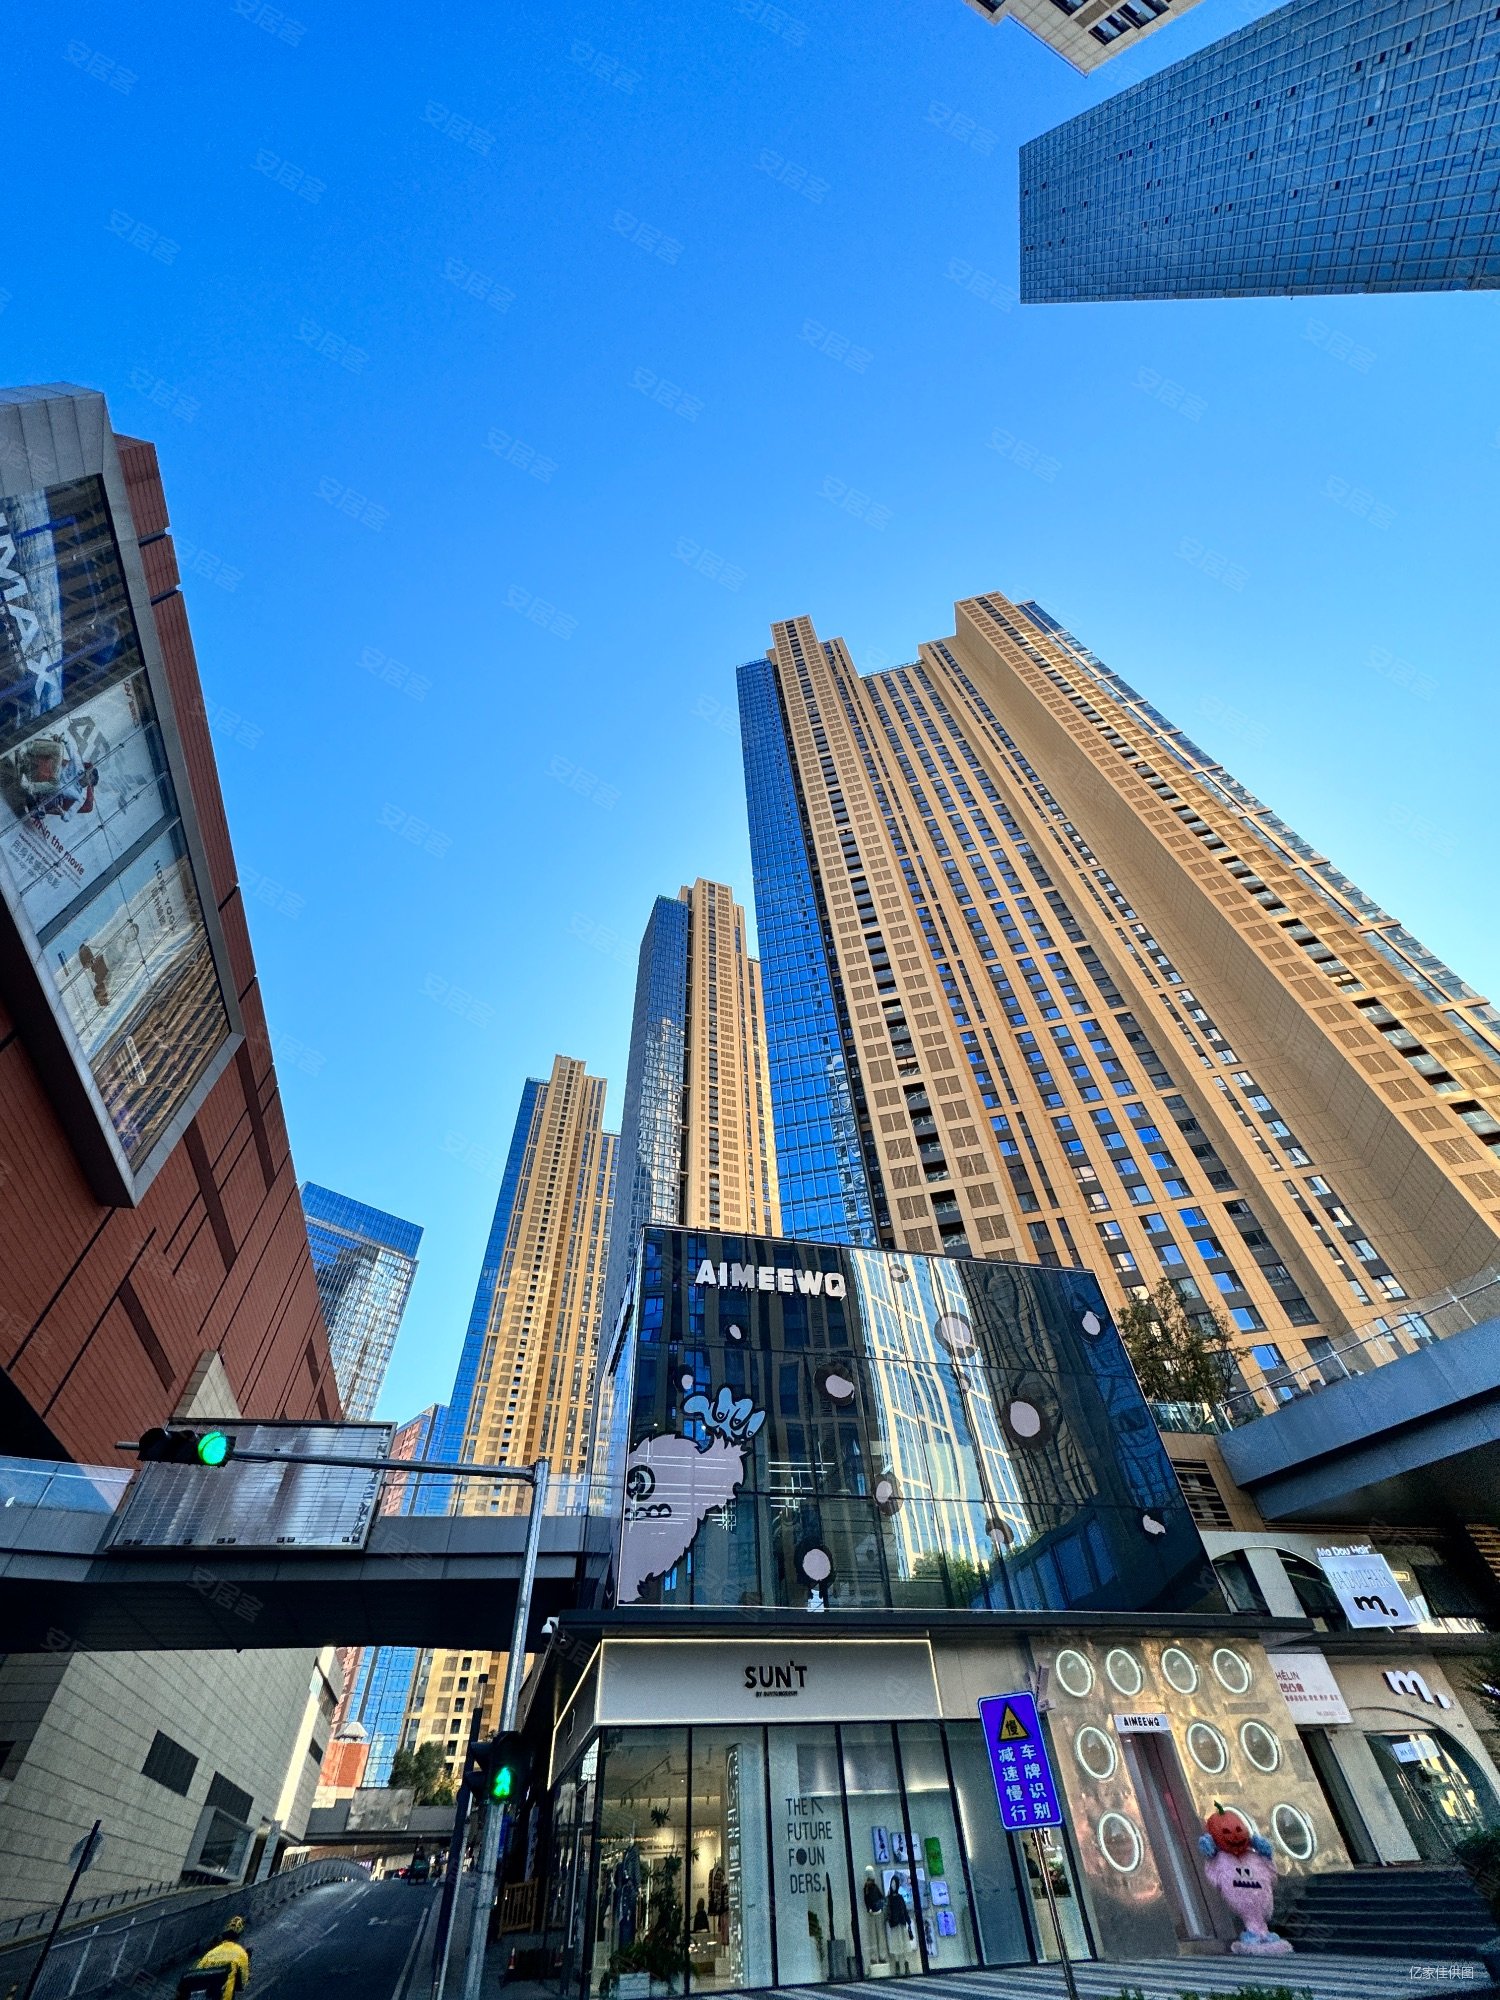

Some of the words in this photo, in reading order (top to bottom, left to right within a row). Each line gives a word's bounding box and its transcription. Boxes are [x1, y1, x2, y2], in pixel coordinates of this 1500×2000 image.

[51, 835, 64, 853] the
[63, 851, 85, 876] movie
[1331, 1545, 1350, 1556] Dou
[1005, 1719, 1019, 1736] 慢
[998, 1746, 1028, 1822] 减速慢行
[1020, 1744, 1052, 1820] 车牌识别
[785, 1797, 808, 1816] THE
[787, 1821, 832, 1841] FUTURE
